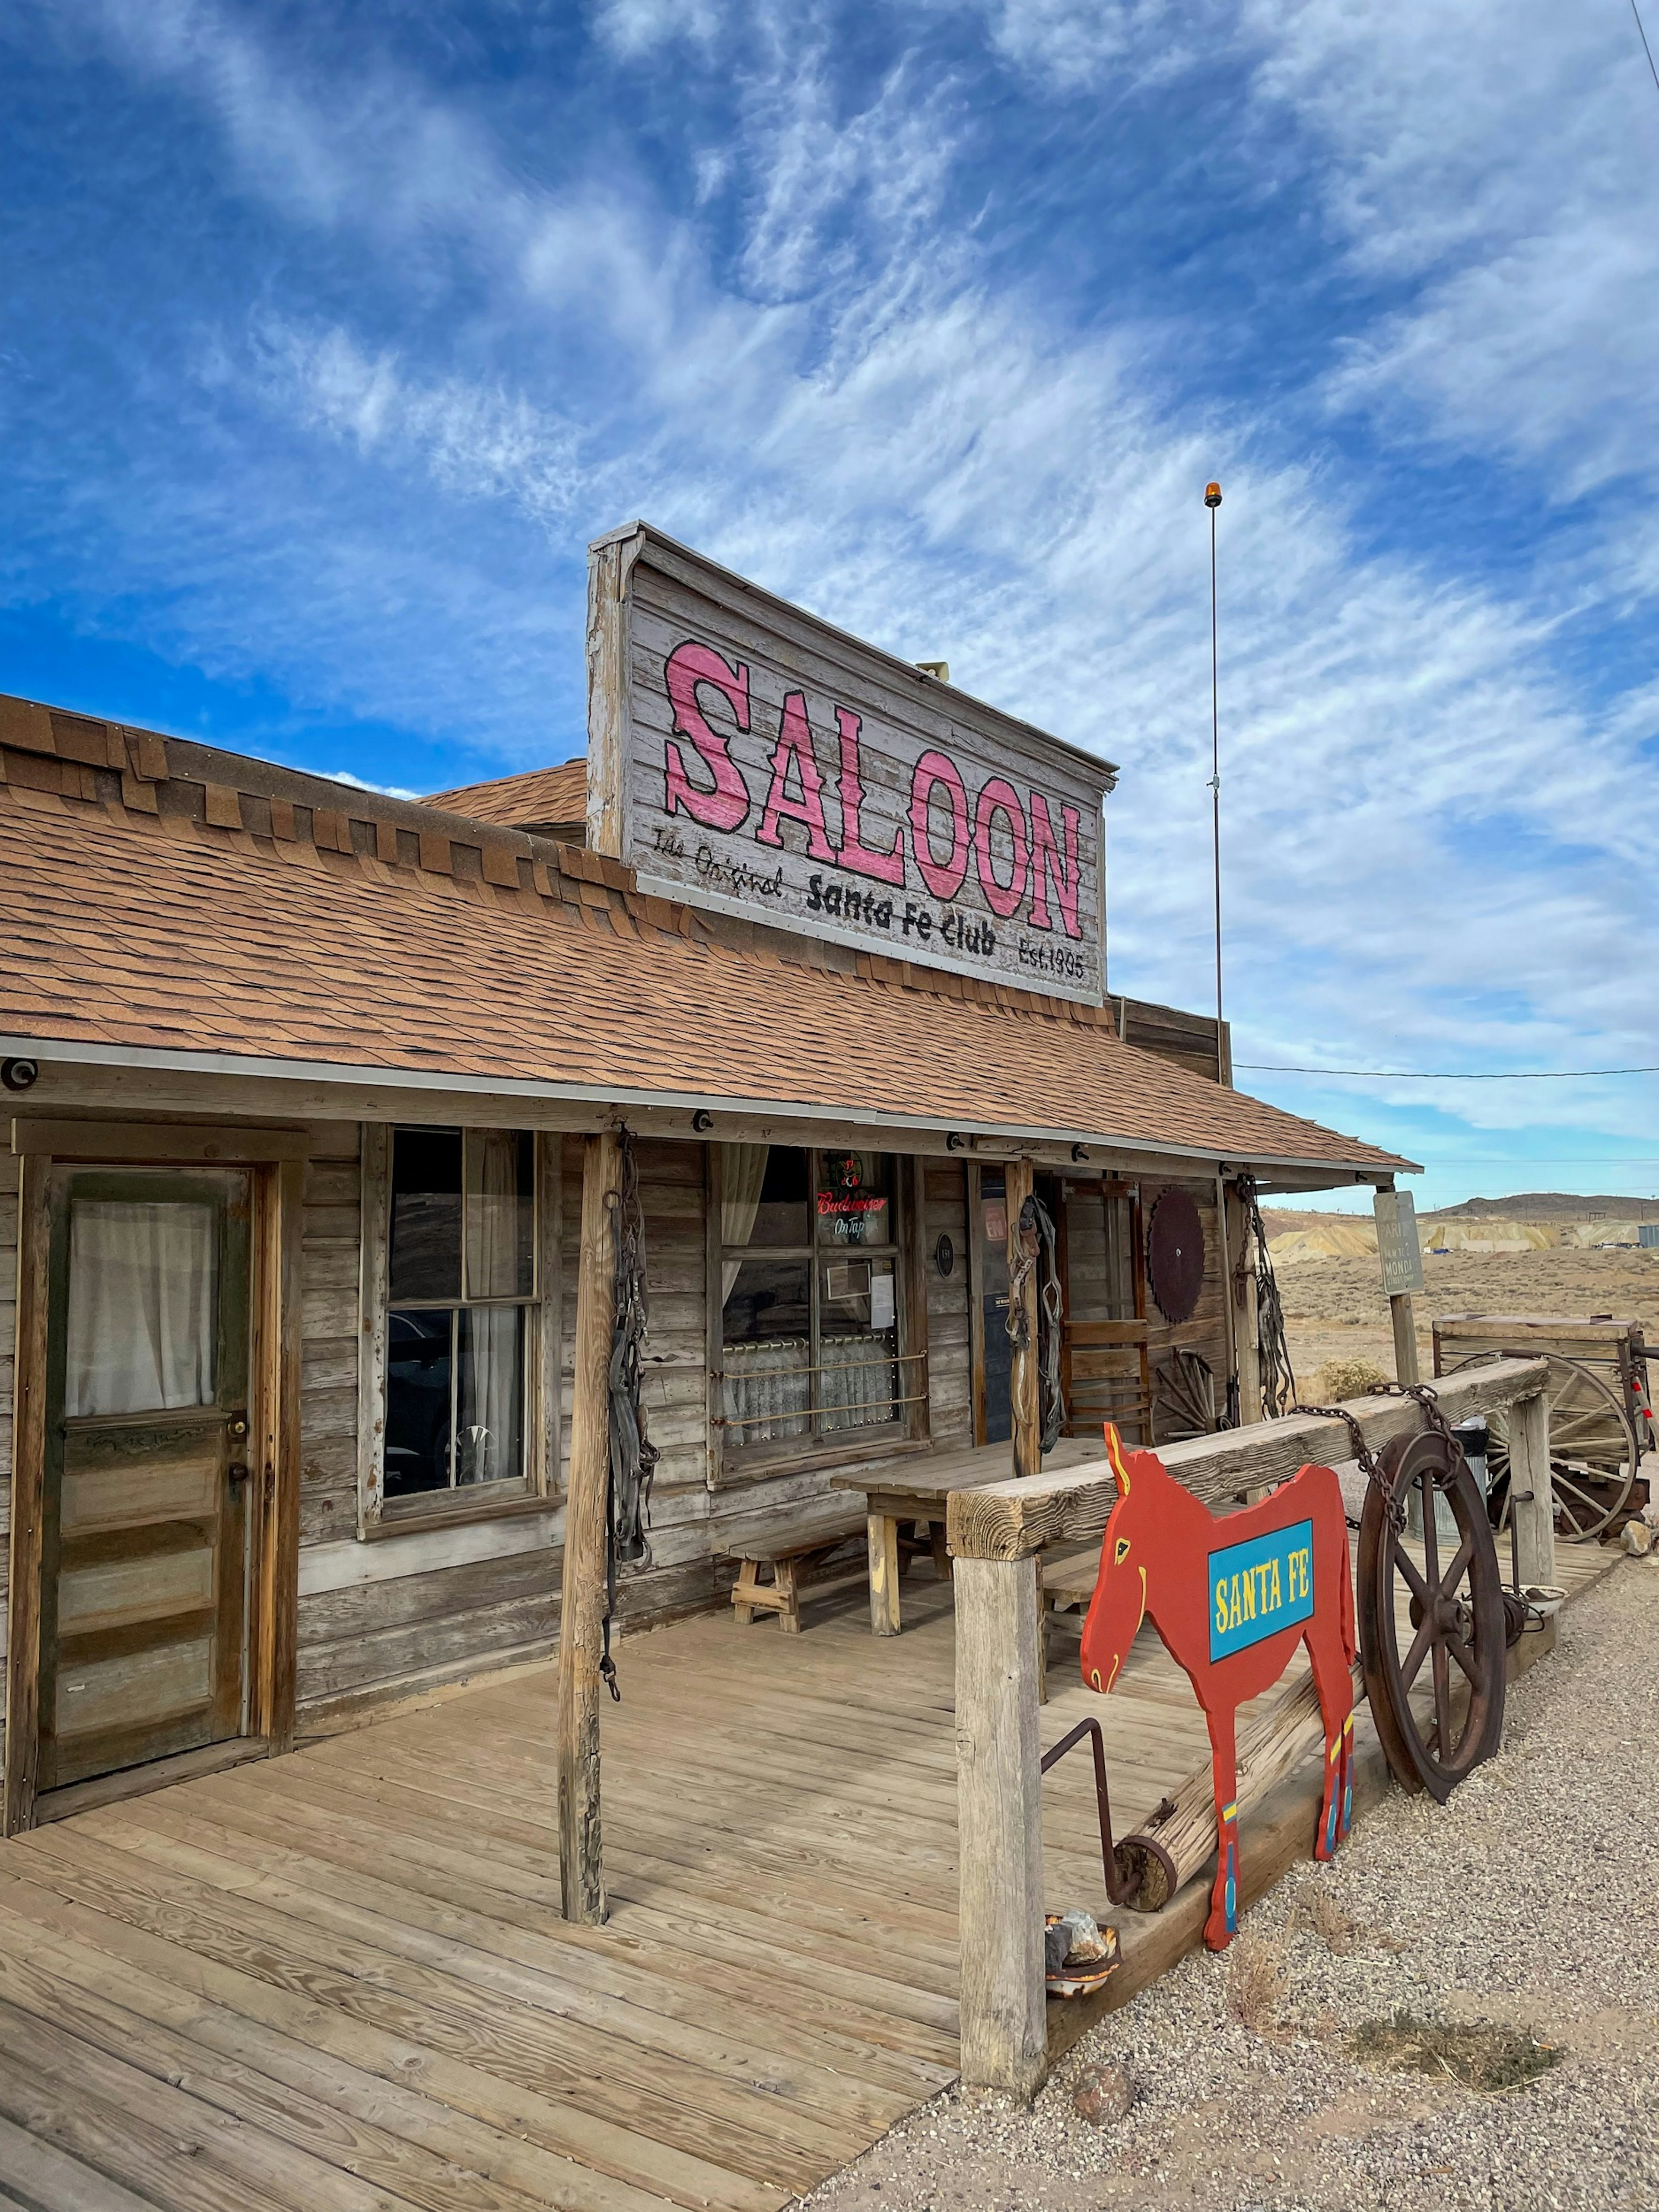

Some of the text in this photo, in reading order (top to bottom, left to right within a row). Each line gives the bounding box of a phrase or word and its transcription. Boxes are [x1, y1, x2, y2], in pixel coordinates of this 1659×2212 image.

[663, 639, 1083, 940] SALOON
[696, 845, 782, 899] Original
[807, 874, 893, 929] Santa
[903, 902, 932, 940] Fe
[817, 1192, 886, 1215] Budweiser
[834, 1217, 864, 1239] On Tap
[1385, 1257, 1417, 1277] MONDA
[1215, 1547, 1309, 1634] SANTA FE
